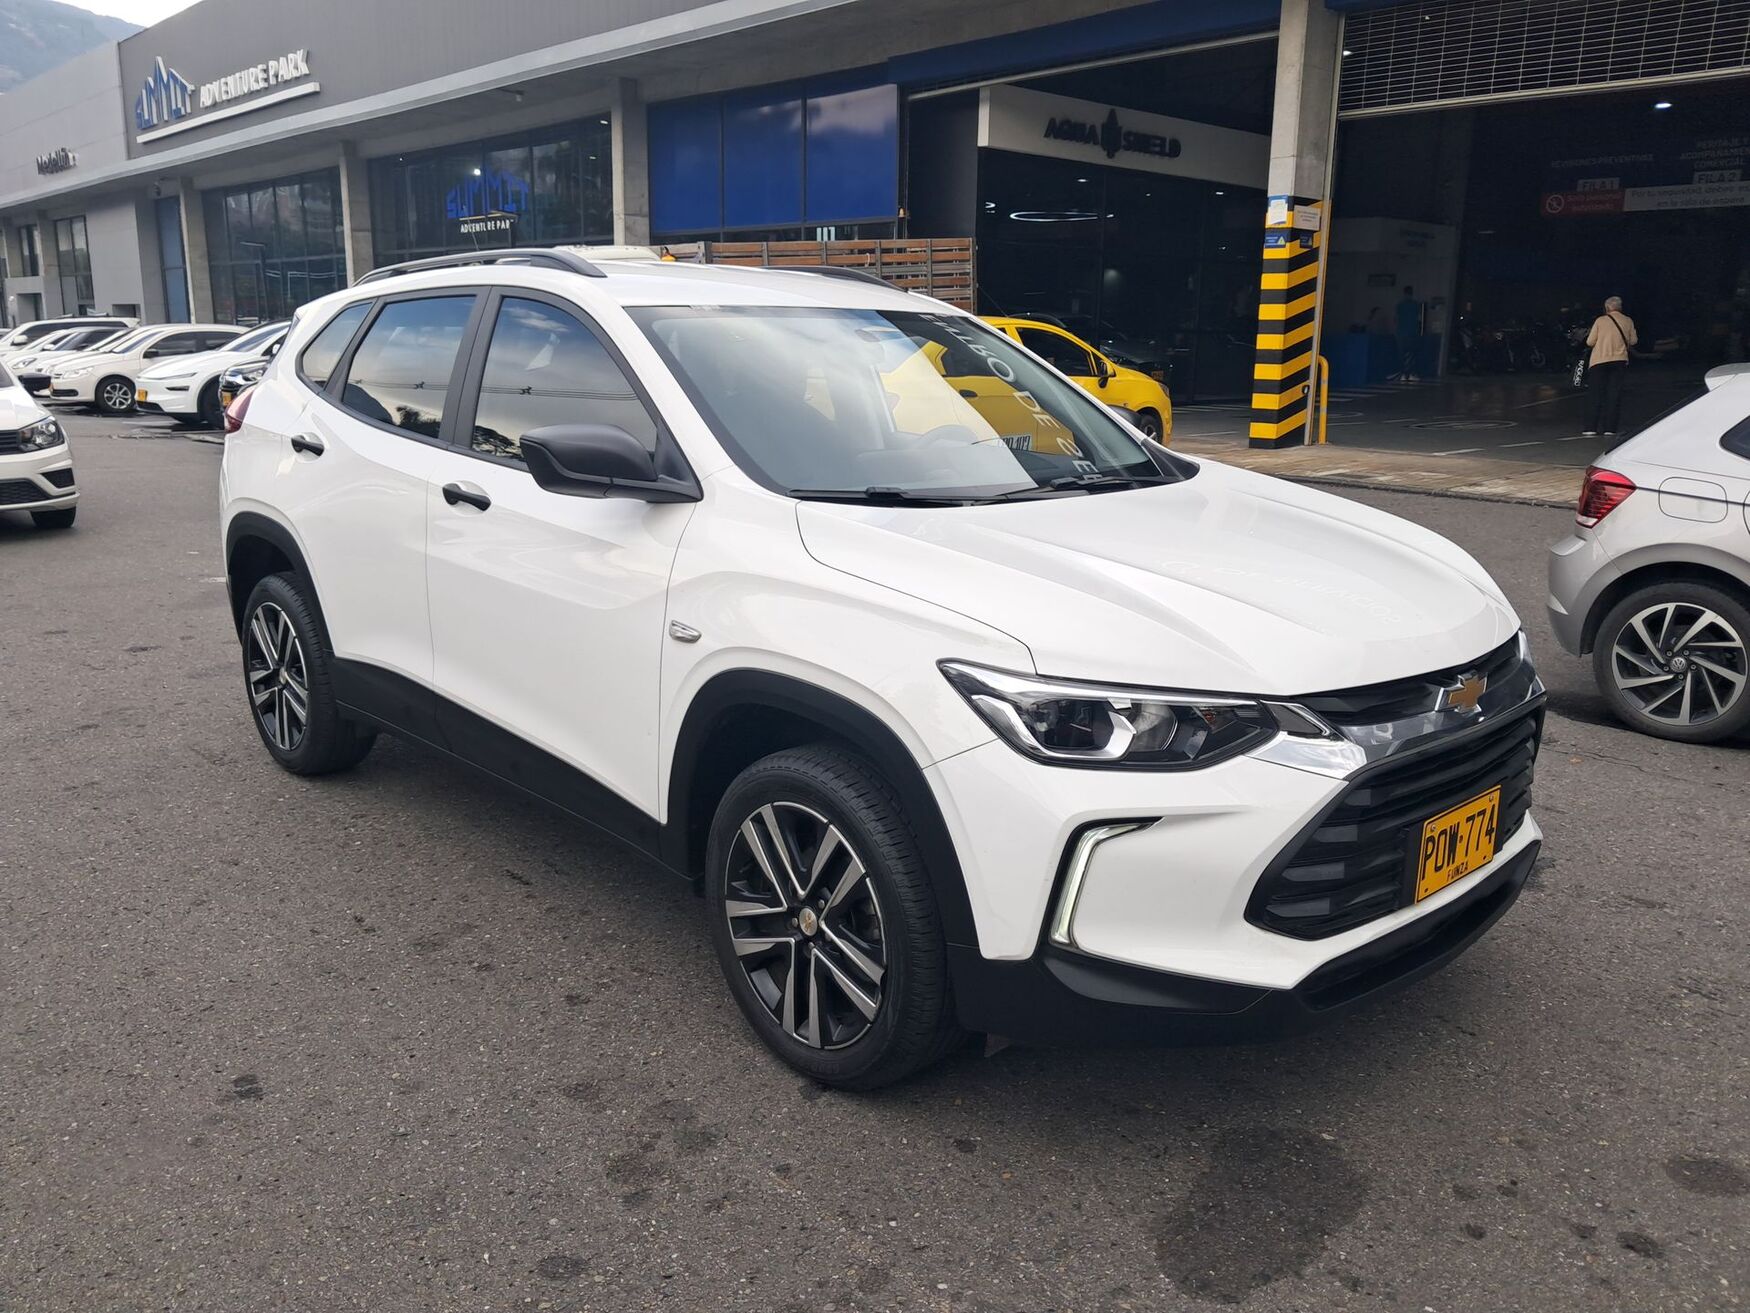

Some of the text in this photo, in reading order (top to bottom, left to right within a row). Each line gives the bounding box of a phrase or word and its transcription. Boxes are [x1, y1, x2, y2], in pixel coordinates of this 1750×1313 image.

[200, 64, 269, 108] ADVENTURE
[268, 49, 310, 85] PARK
[1698, 172, 1737, 184] FILA 2
[1582, 180, 1606, 192] FILA
[497, 219, 514, 231] PAR
[1447, 862, 1468, 881] FUNZA
